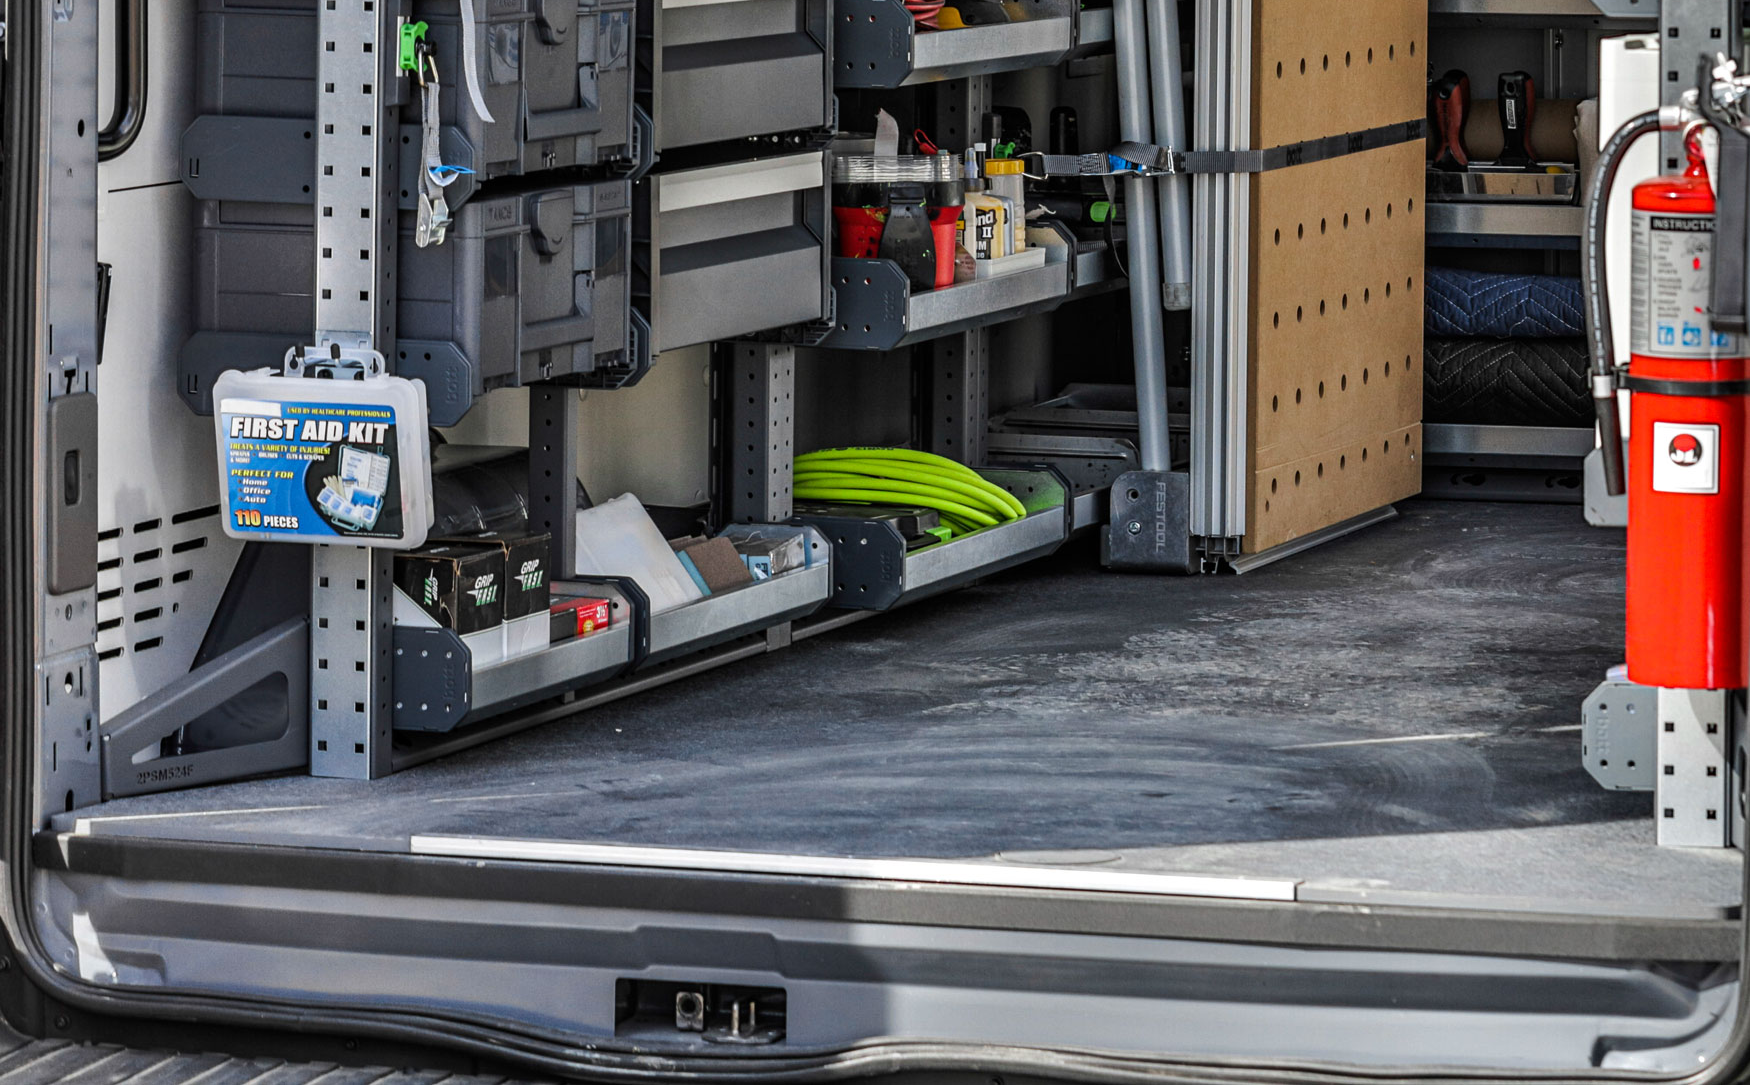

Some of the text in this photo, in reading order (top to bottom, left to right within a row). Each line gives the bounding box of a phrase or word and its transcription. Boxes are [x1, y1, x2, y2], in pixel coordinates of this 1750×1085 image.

[975, 210, 994, 226] nd
[312, 408, 346, 416] HEALTHCARE
[347, 409, 391, 418] PROFESSIONALS
[230, 417, 390, 444] FIRST AID KIT
[262, 444, 288, 452] VARIETY
[290, 445, 298, 453] OF
[299, 445, 331, 455] INJURIES!
[231, 469, 294, 479] PERFECT FOR
[242, 478, 268, 486] Home
[243, 487, 272, 495] Office
[243, 495, 267, 503] Auto
[234, 509, 299, 529] 110 PIECES
[1156, 480, 1167, 553] FESTOOL
[521, 559, 540, 575] GRIP
[474, 573, 495, 590] GRIP
[136, 764, 194, 785] 2PSM524F
